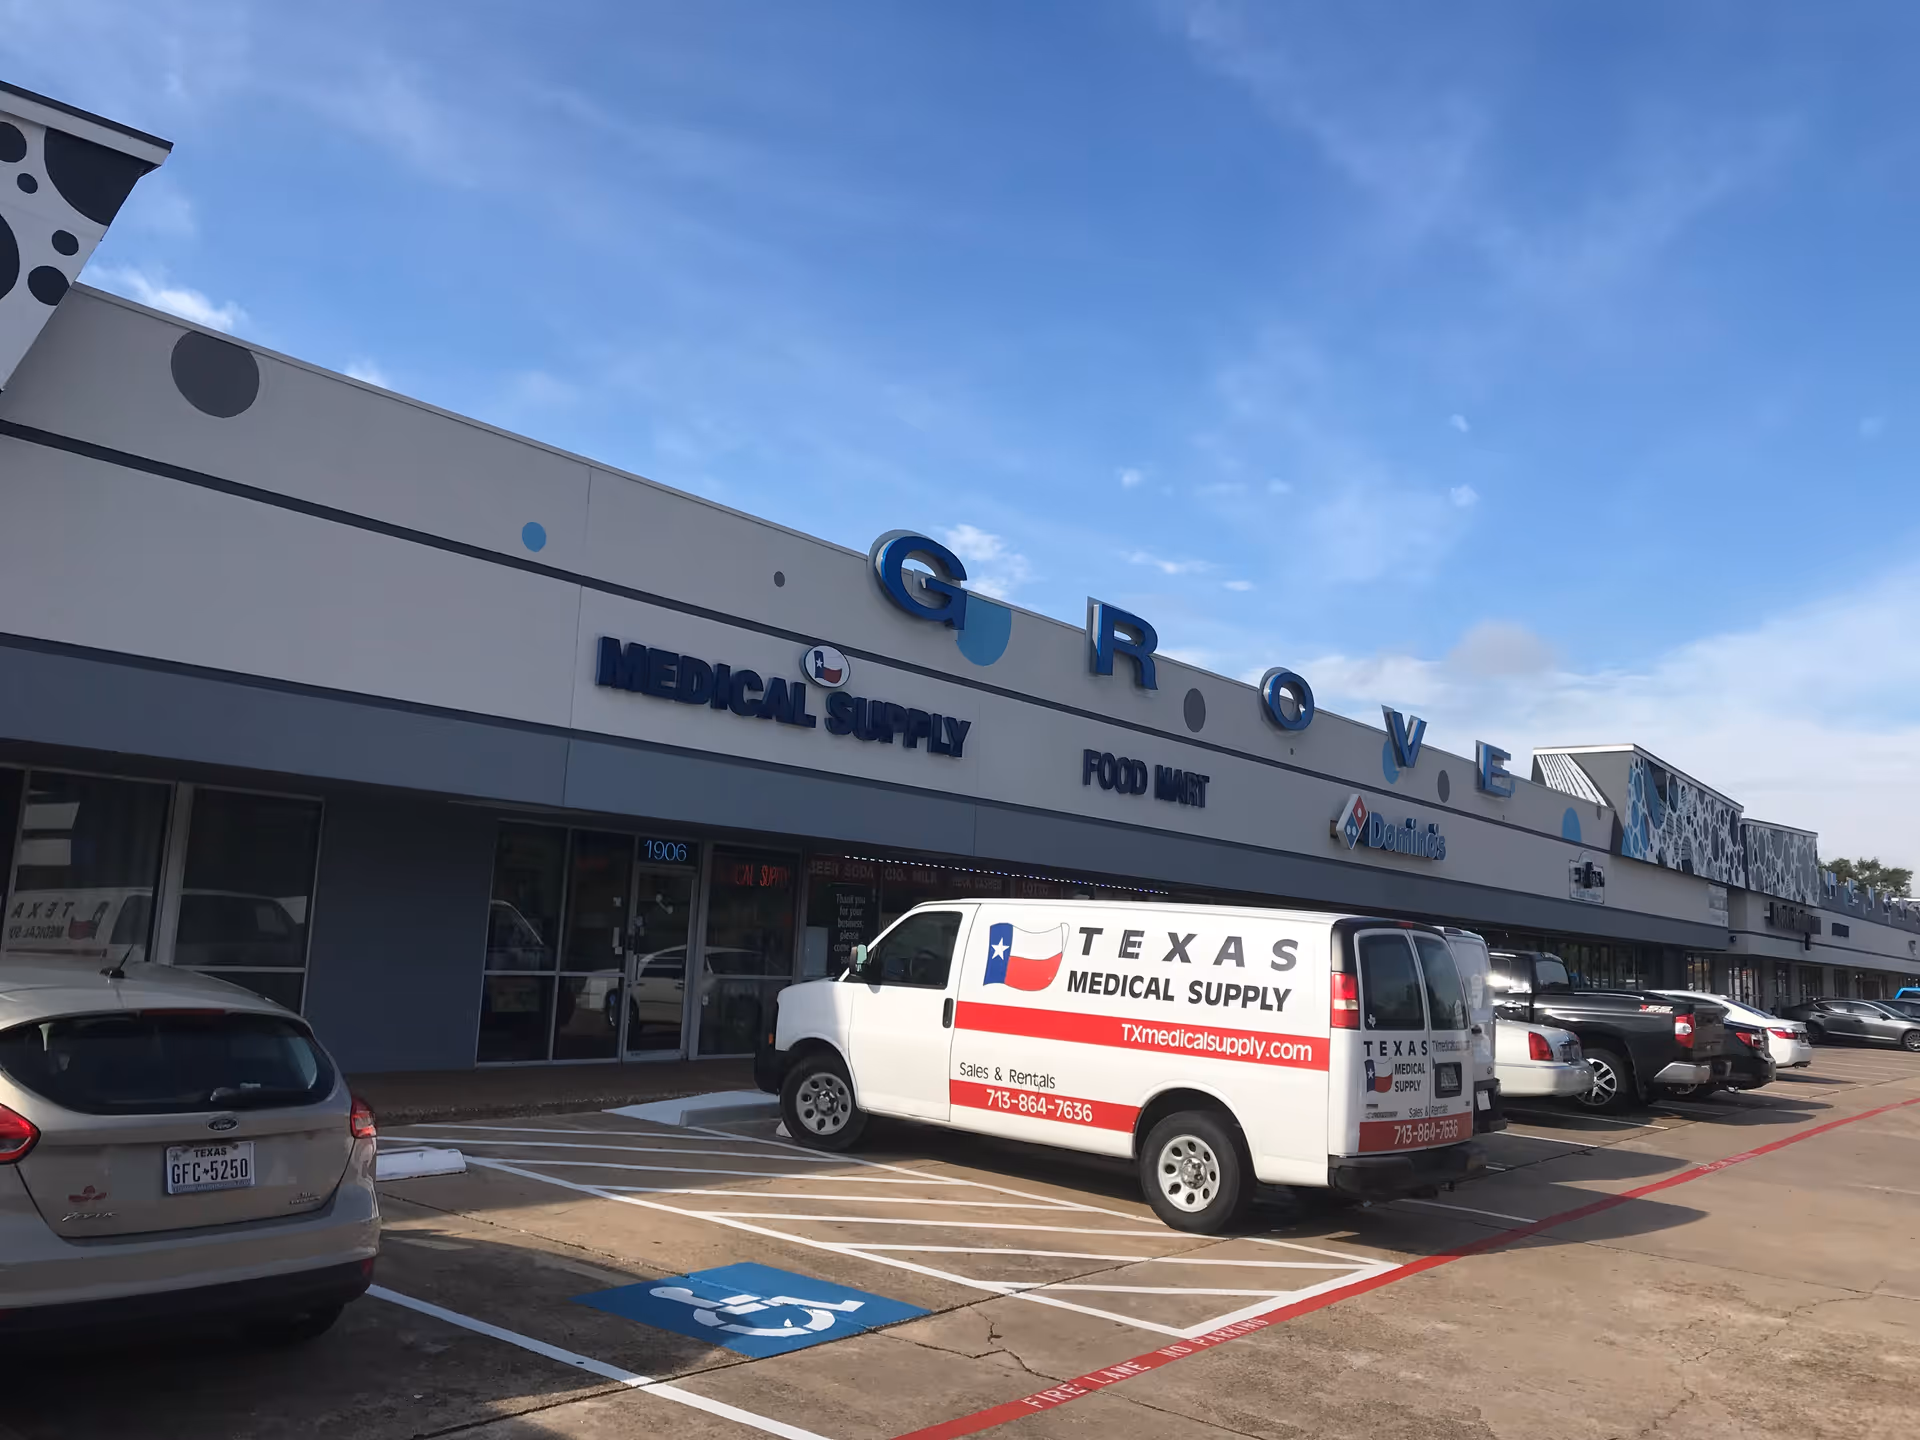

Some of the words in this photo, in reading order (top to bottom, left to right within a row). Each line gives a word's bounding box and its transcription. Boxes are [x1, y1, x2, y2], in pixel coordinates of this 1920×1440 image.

[869, 530, 1514, 798] GROVE
[596, 636, 816, 728] MEDICAL
[825, 691, 971, 757] SUPPLY
[1082, 749, 1148, 795] FOOD
[1154, 764, 1210, 808] MART
[644, 839, 687, 861] 1906
[1368, 811, 1446, 860] Domino's
[1078, 926, 1299, 972] TEXAS
[1067, 970, 1175, 1002] MEDICAL
[1188, 980, 1292, 1012] SUPPLY
[1121, 1023, 1313, 1061] TXmedicalsupply.com
[1363, 1040, 1428, 1056] TEXAS
[959, 1062, 989, 1080] Sales
[994, 1066, 1003, 1081] &
[1009, 1069, 1056, 1089] Rentals
[1394, 1062, 1426, 1075] MEDICAL
[1394, 1080, 1422, 1092] SUPPLY
[986, 1088, 1093, 1122] 713-864-7636
[1408, 1107, 1424, 1118] Sales
[1431, 1104, 1448, 1116] Rentals
[1393, 1119, 1458, 1145] 713-864-7636
[193, 1147, 227, 1158] TEXAS
[1020, 1382, 1086, 1409] FIRE
[1084, 1361, 1152, 1385] LANE
[1156, 1345, 1193, 1358] NO
[1188, 1319, 1269, 1346] PARKING
